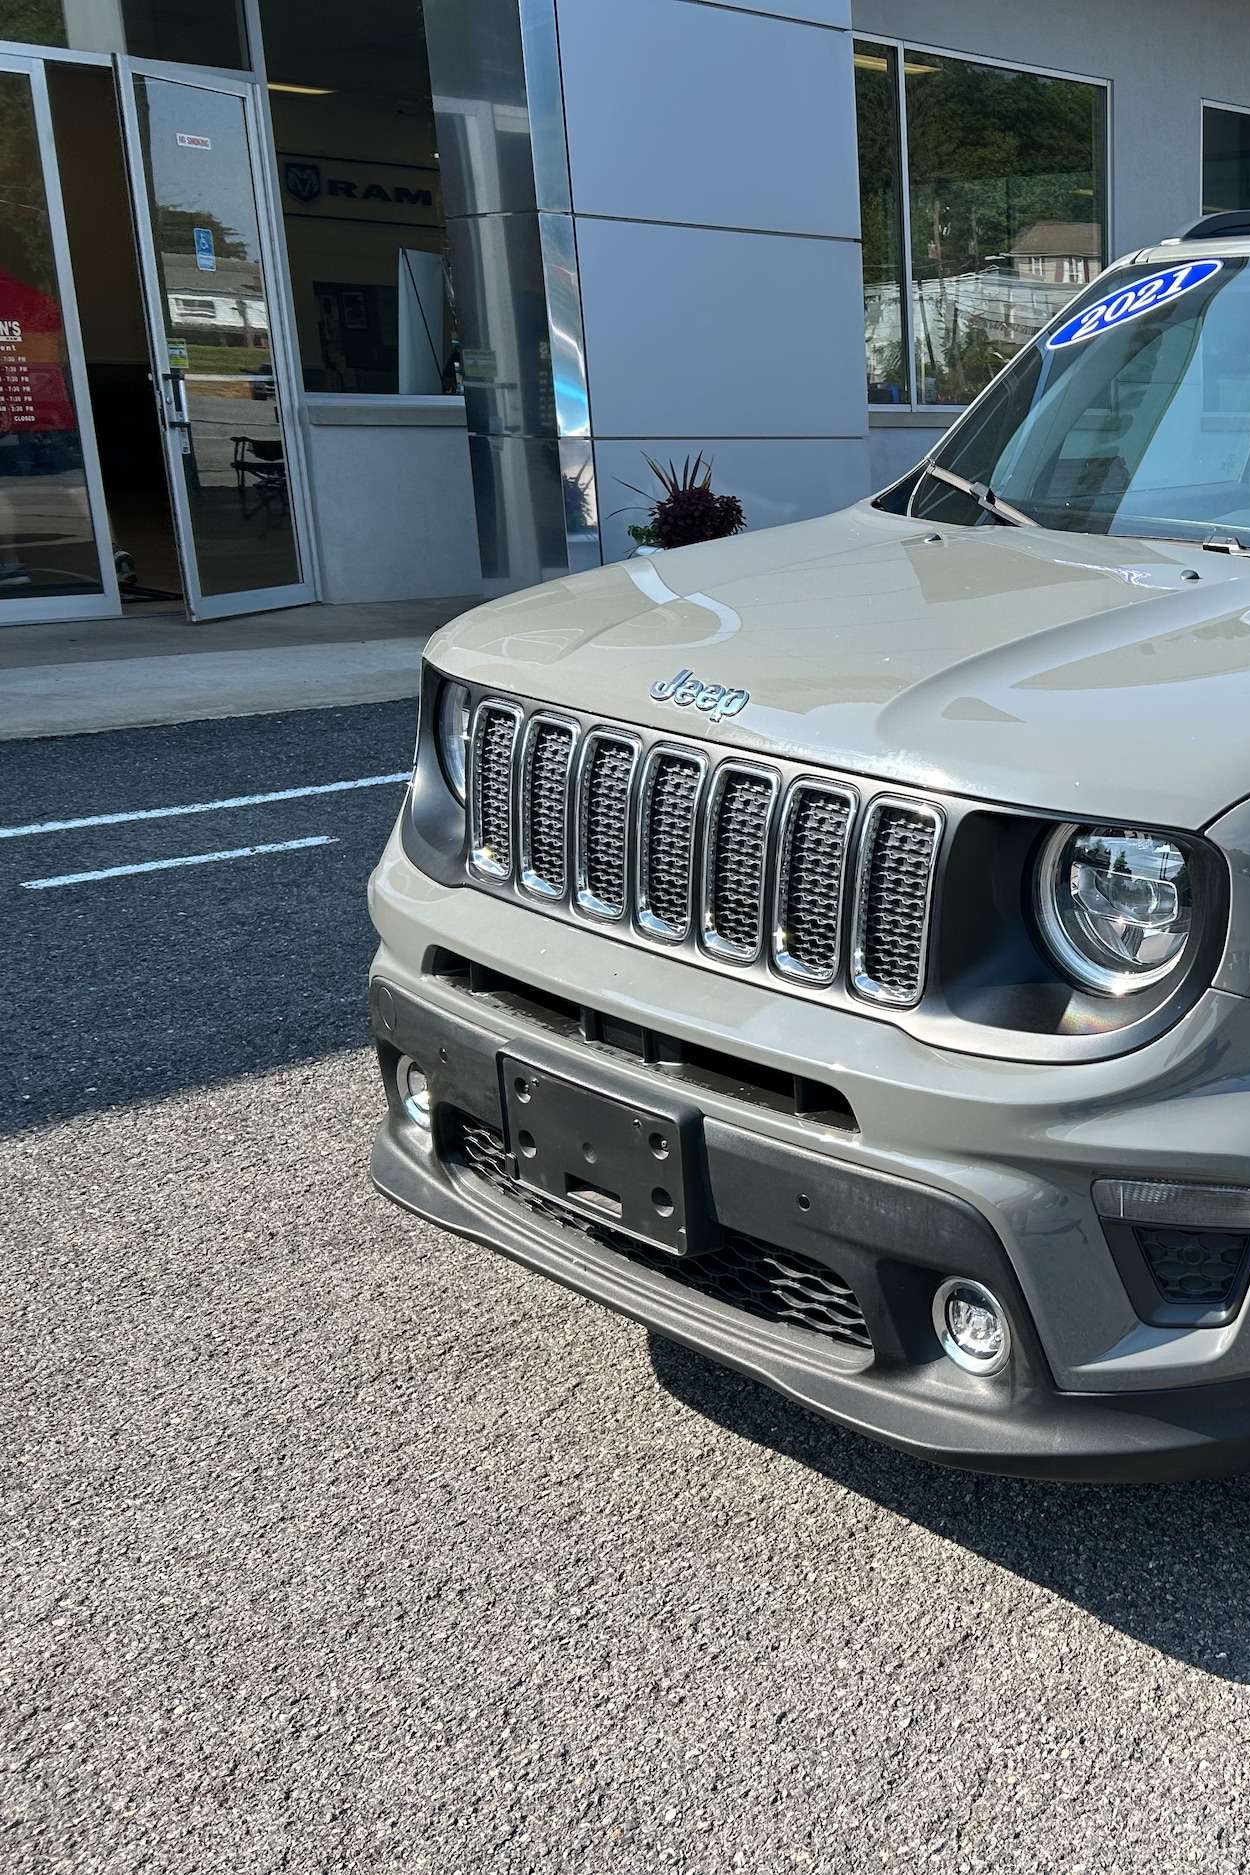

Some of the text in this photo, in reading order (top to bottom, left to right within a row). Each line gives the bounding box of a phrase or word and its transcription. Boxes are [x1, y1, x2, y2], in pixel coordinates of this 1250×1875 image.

[327, 179, 433, 206] RAM
[1070, 266, 1193, 341] 2021
[650, 669, 750, 723] Jeep
